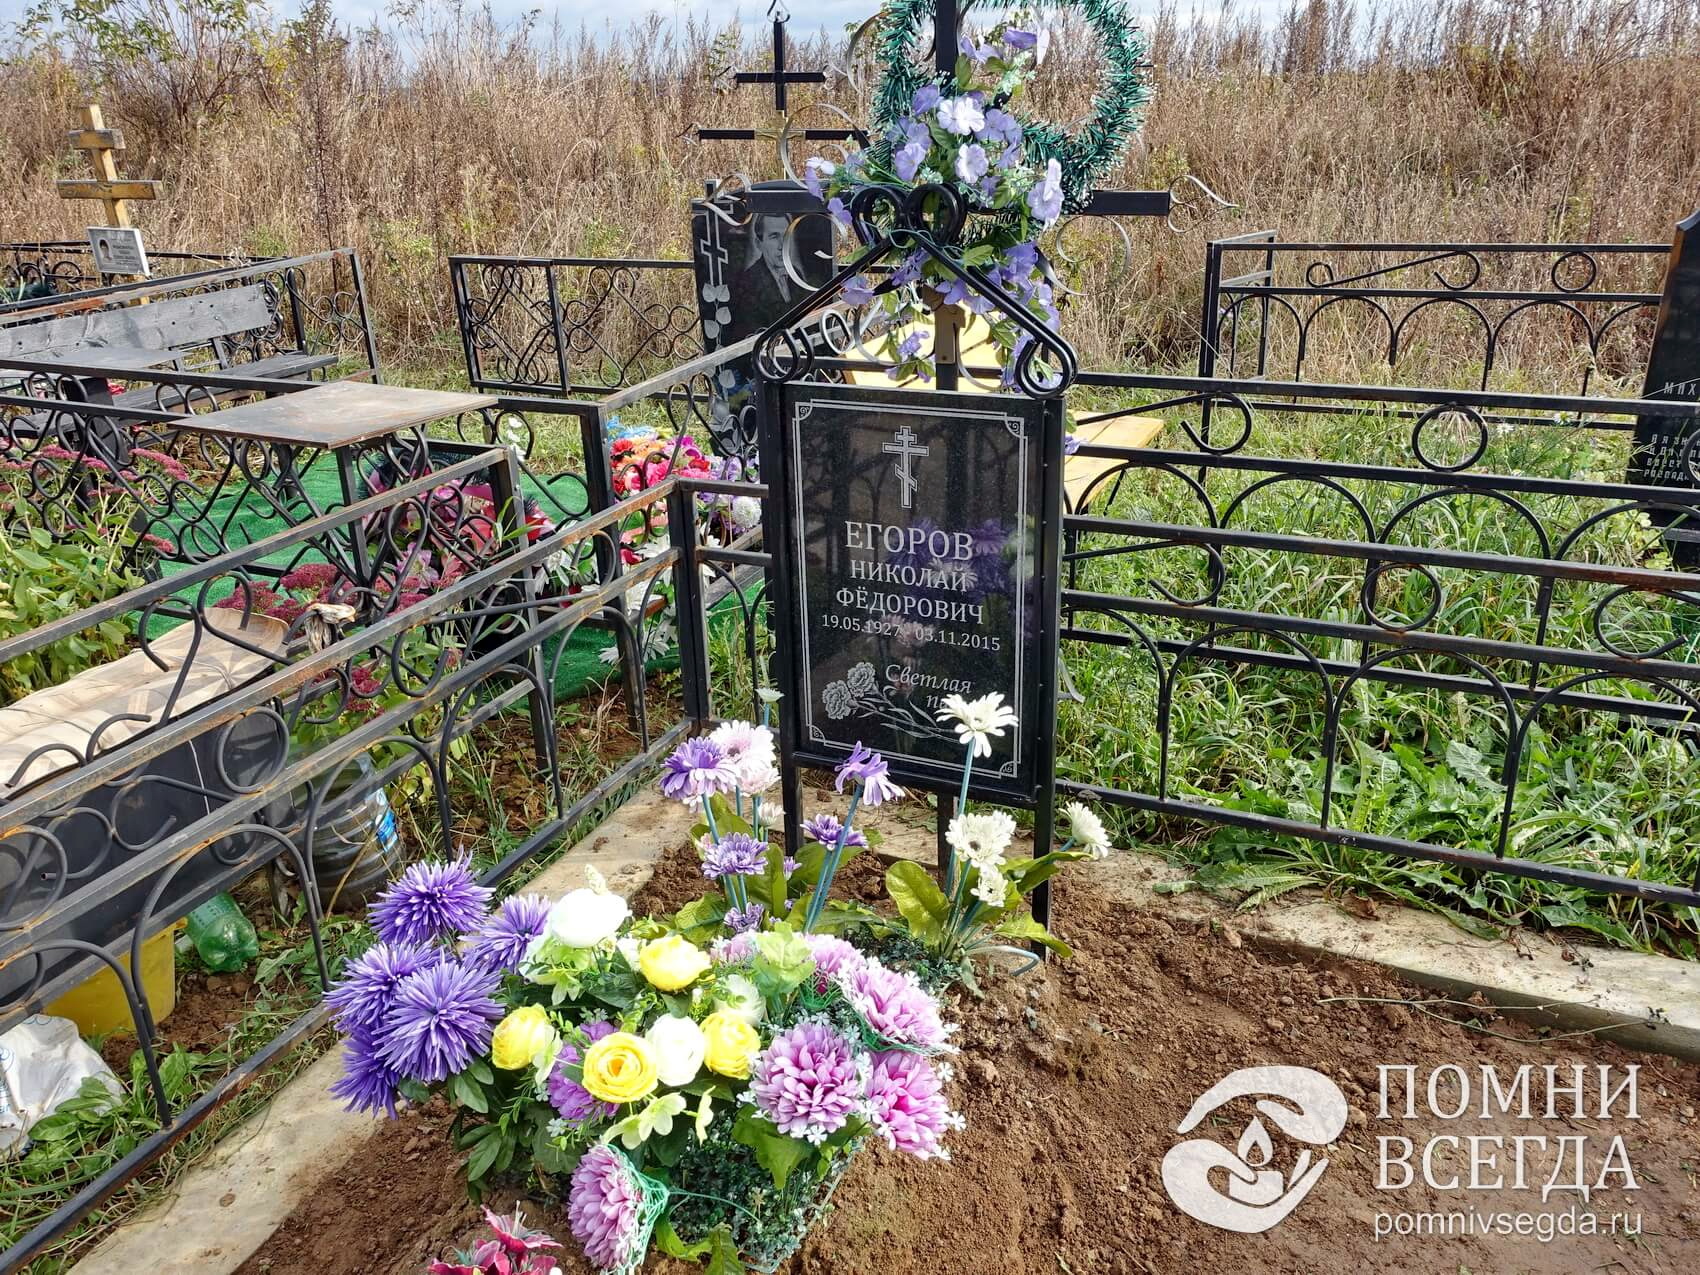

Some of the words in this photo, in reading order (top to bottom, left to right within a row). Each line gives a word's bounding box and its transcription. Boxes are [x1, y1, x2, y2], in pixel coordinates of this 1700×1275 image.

[844, 520, 974, 561] ЕГОРОВ
[850, 559, 968, 593] НИКОЛАЙ
[836, 586, 985, 625] ФЁДОРОВИЧ
[822, 614, 901, 637] 19.05.1927
[885, 664, 972, 693] Светлая
